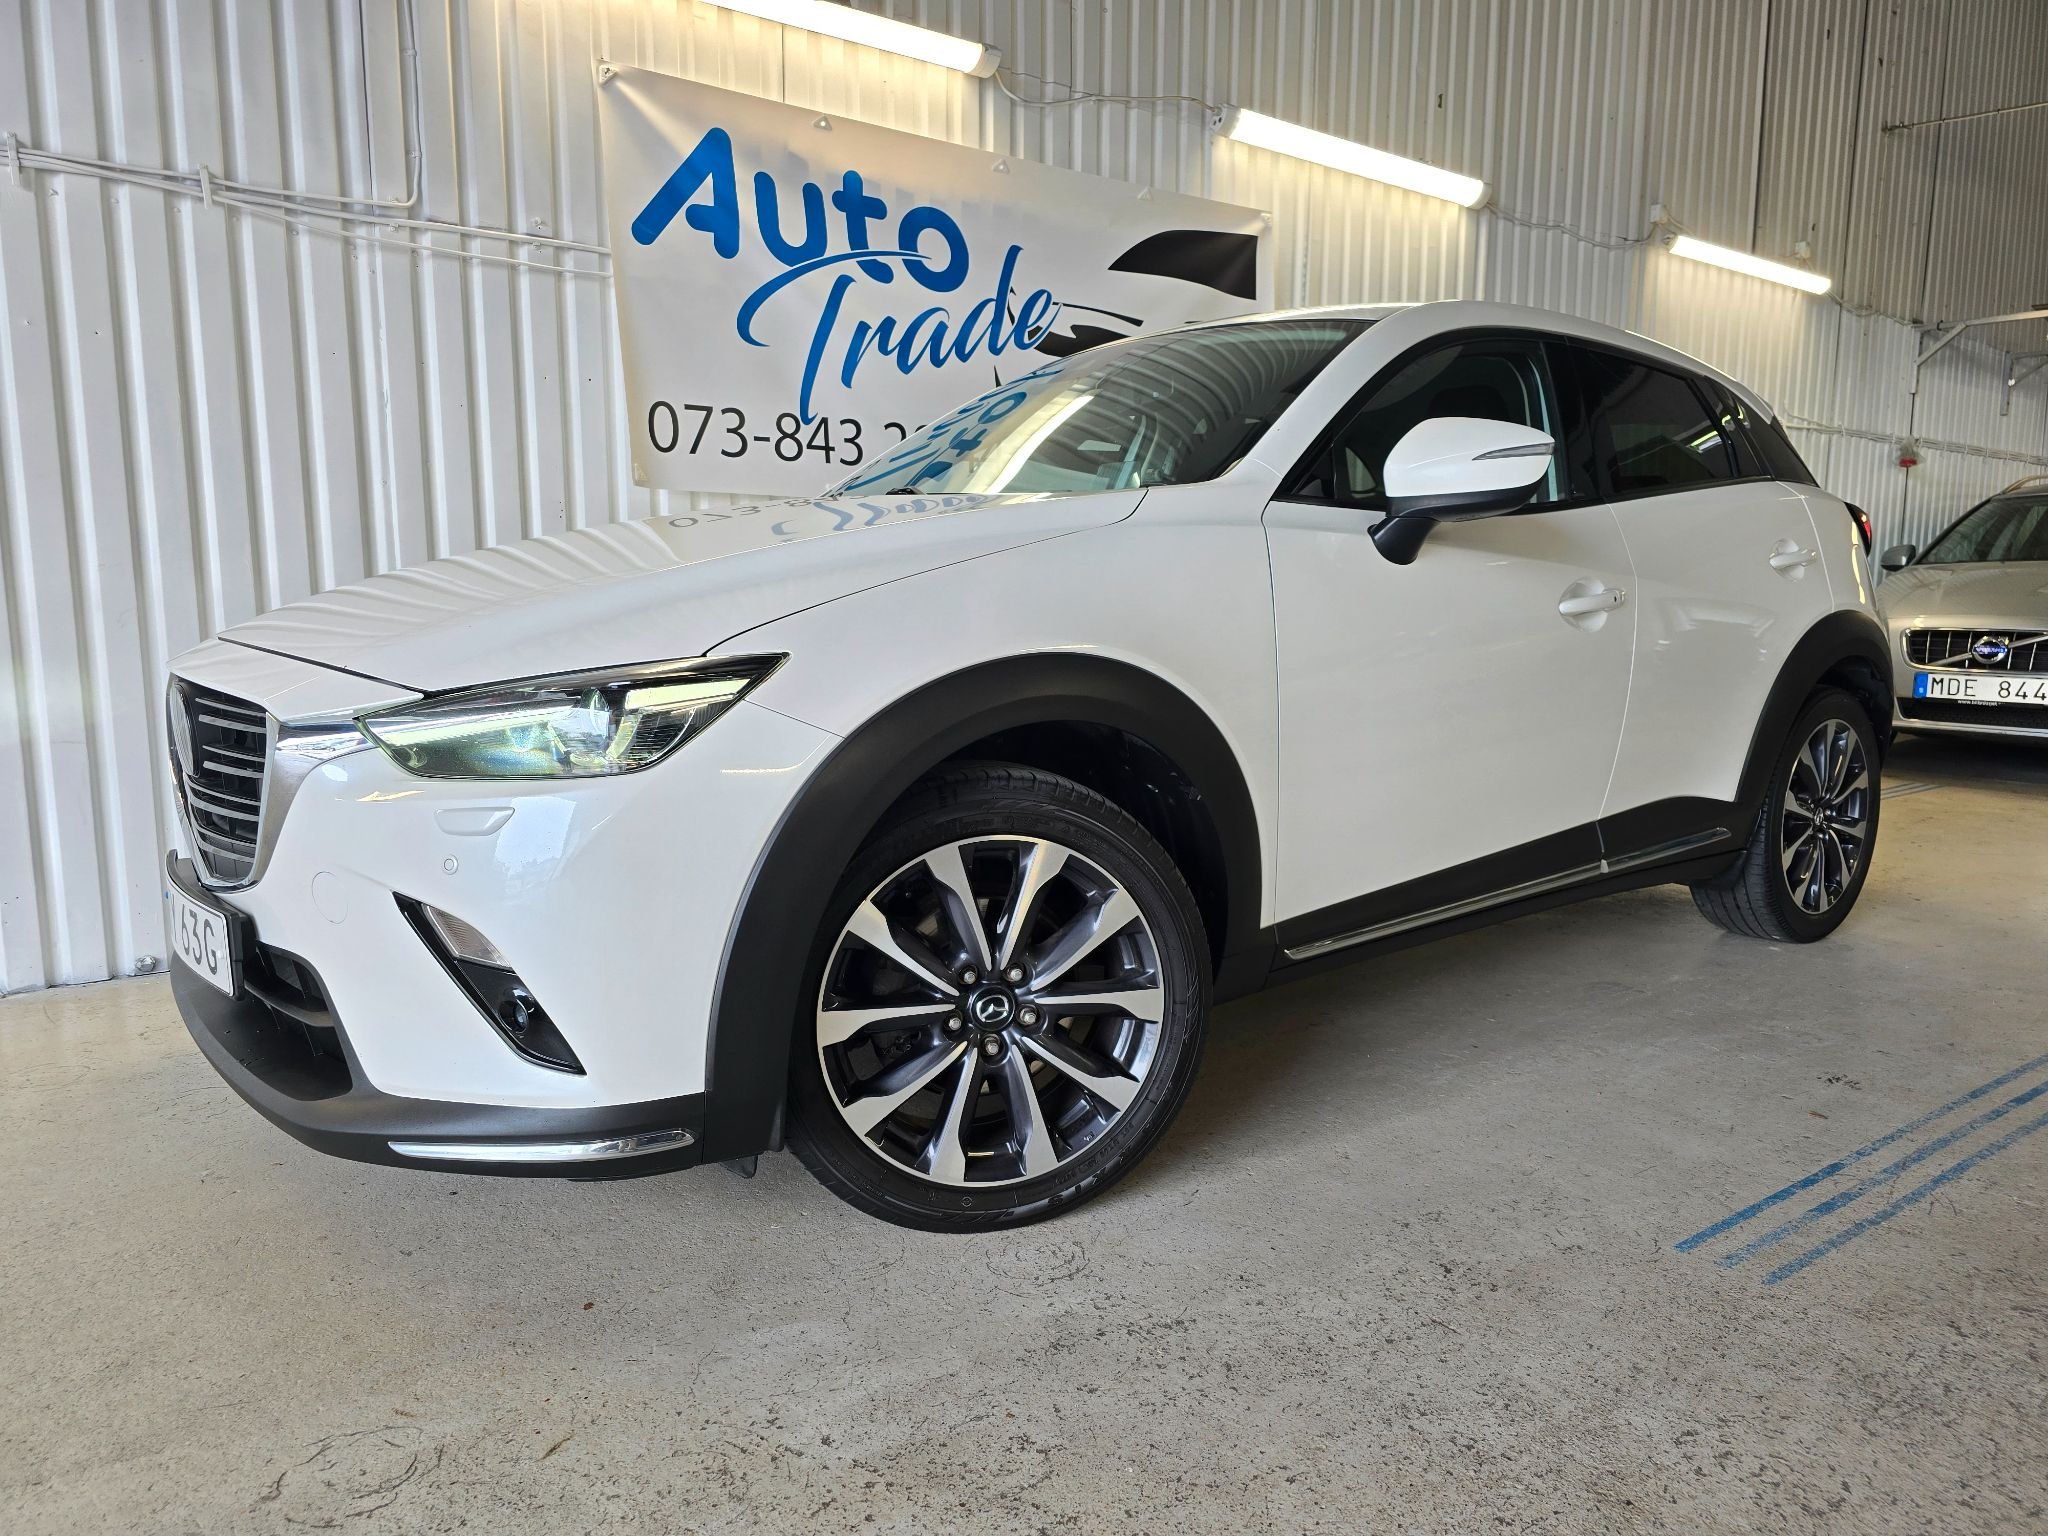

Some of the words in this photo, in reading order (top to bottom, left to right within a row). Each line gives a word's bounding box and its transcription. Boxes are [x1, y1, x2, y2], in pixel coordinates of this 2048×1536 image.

[631, 128, 970, 293] Auto
[736, 245, 1062, 425] Trade
[648, 400, 864, 467] 073-843
[1930, 676, 1978, 697] MDE
[1998, 680, 2047, 701] 844
[181, 903, 218, 975] 63G
